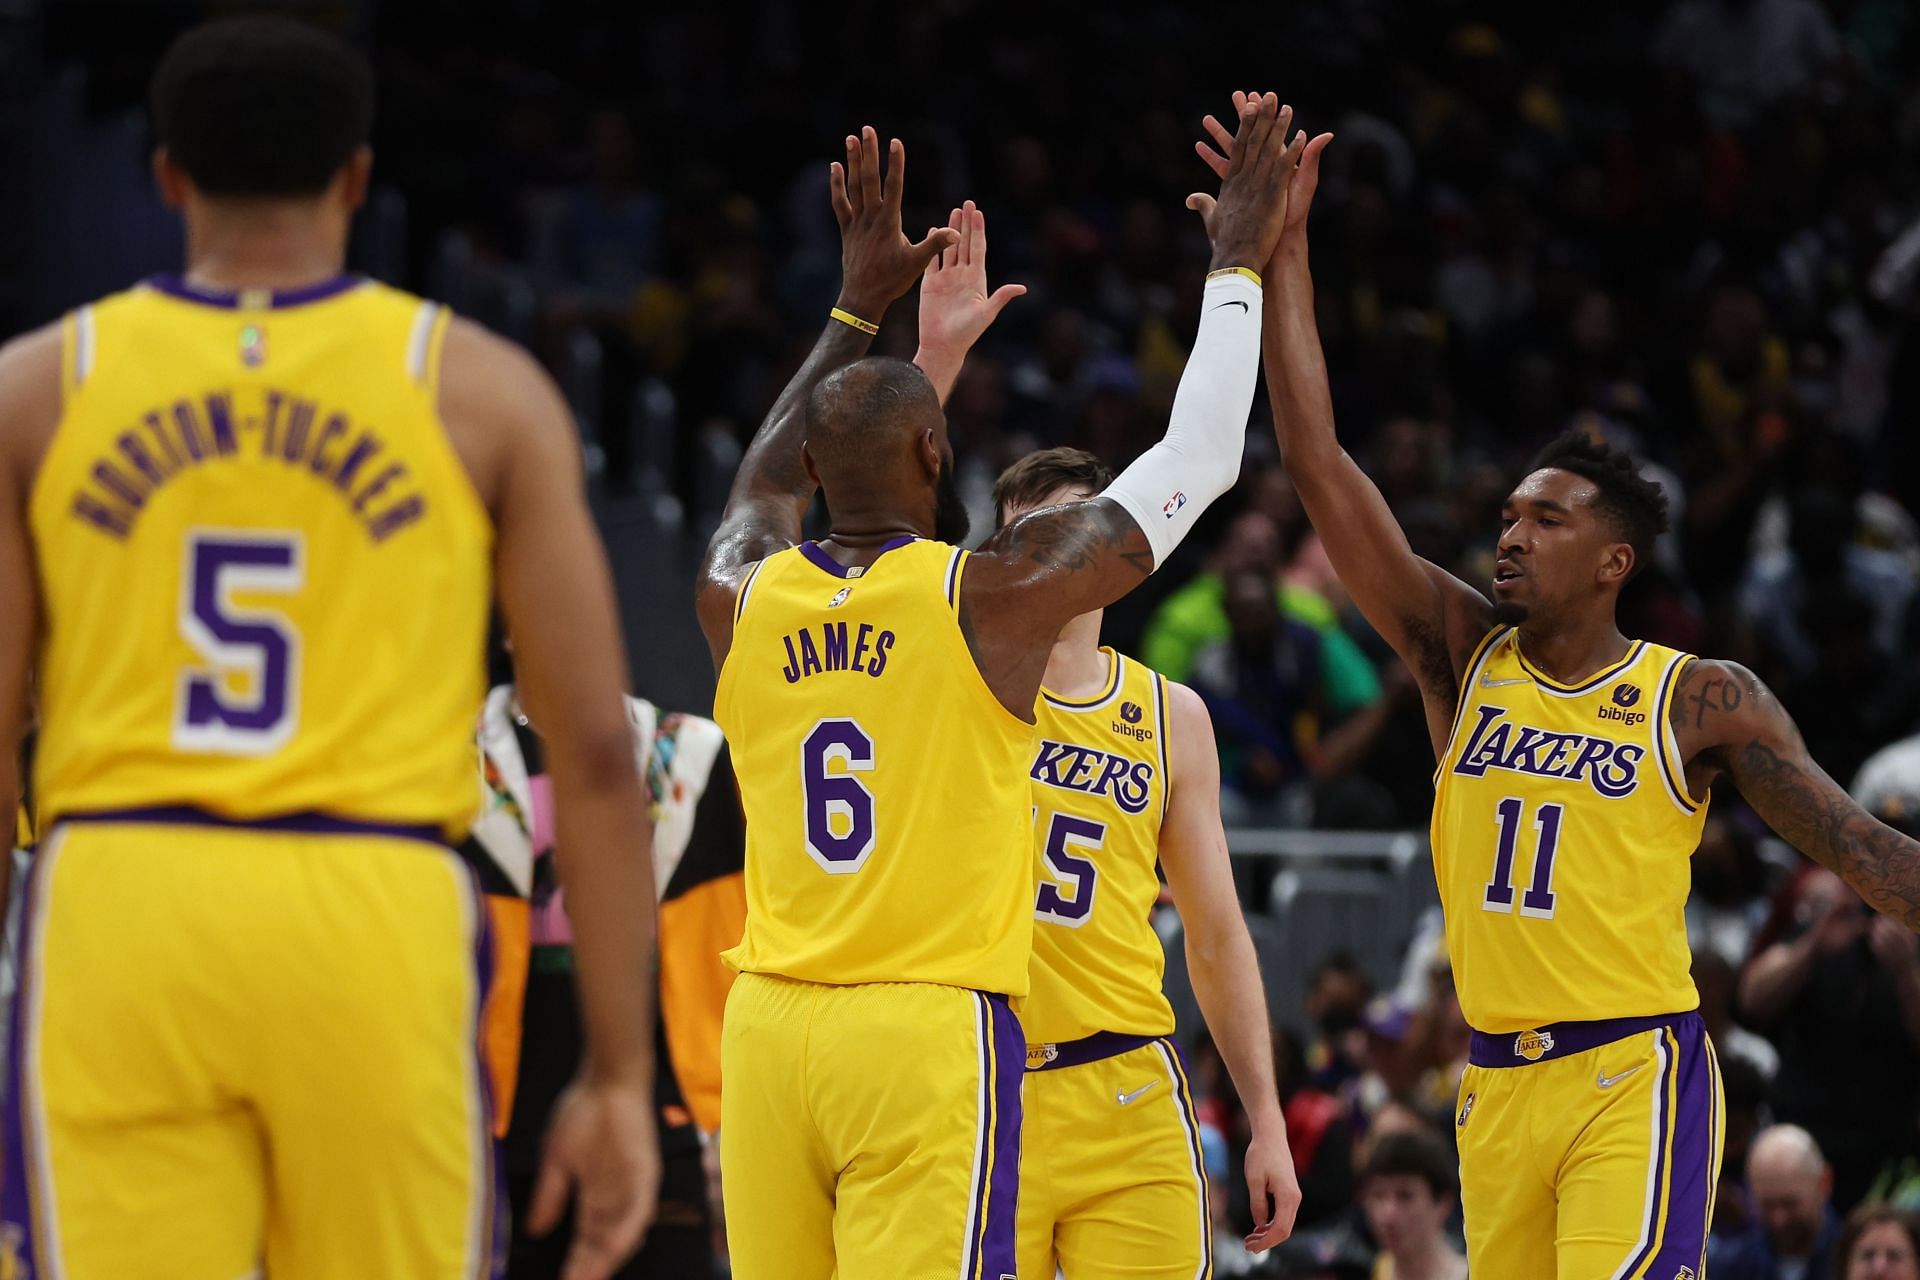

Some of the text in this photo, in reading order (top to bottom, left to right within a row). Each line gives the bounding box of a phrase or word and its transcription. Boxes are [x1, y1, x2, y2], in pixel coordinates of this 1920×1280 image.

[69, 388, 427, 543] HORTON-TUCKER
[176, 530, 304, 752] 5
[782, 621, 896, 684] JAMES
[1112, 720, 1153, 742] bibigo
[1454, 704, 1647, 799] LAKERS
[1598, 705, 1646, 726] bibigo
[800, 717, 876, 874] 6
[1029, 738, 1154, 815] KERS
[1033, 807, 1108, 929] 5
[1482, 796, 1565, 919] 11
[1516, 1037, 1553, 1055] LAKERS
